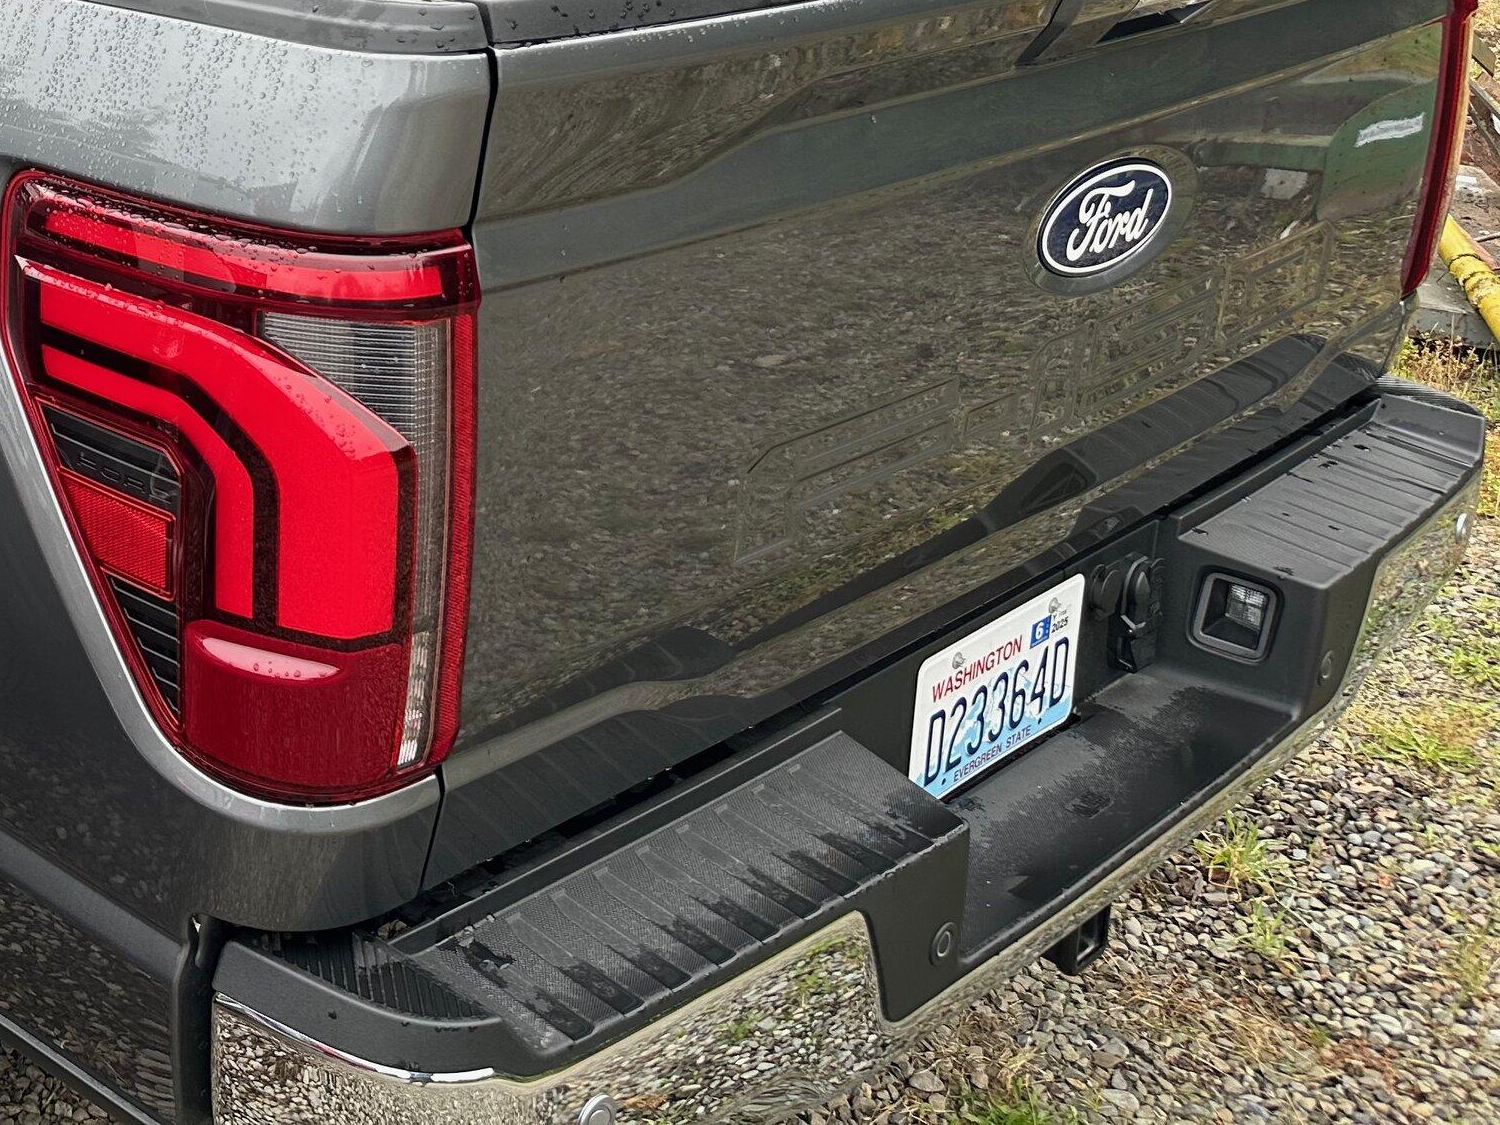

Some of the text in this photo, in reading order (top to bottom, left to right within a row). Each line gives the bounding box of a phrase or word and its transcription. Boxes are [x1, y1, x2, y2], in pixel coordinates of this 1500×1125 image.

[1065, 179, 1154, 262] Ford
[1035, 621, 1045, 640] 6
[1050, 616, 1069, 634] 2025
[932, 634, 1023, 703] WASHINGTON
[923, 636, 1070, 788] D23364D
[953, 725, 1032, 782] EVERGREEN STATE
